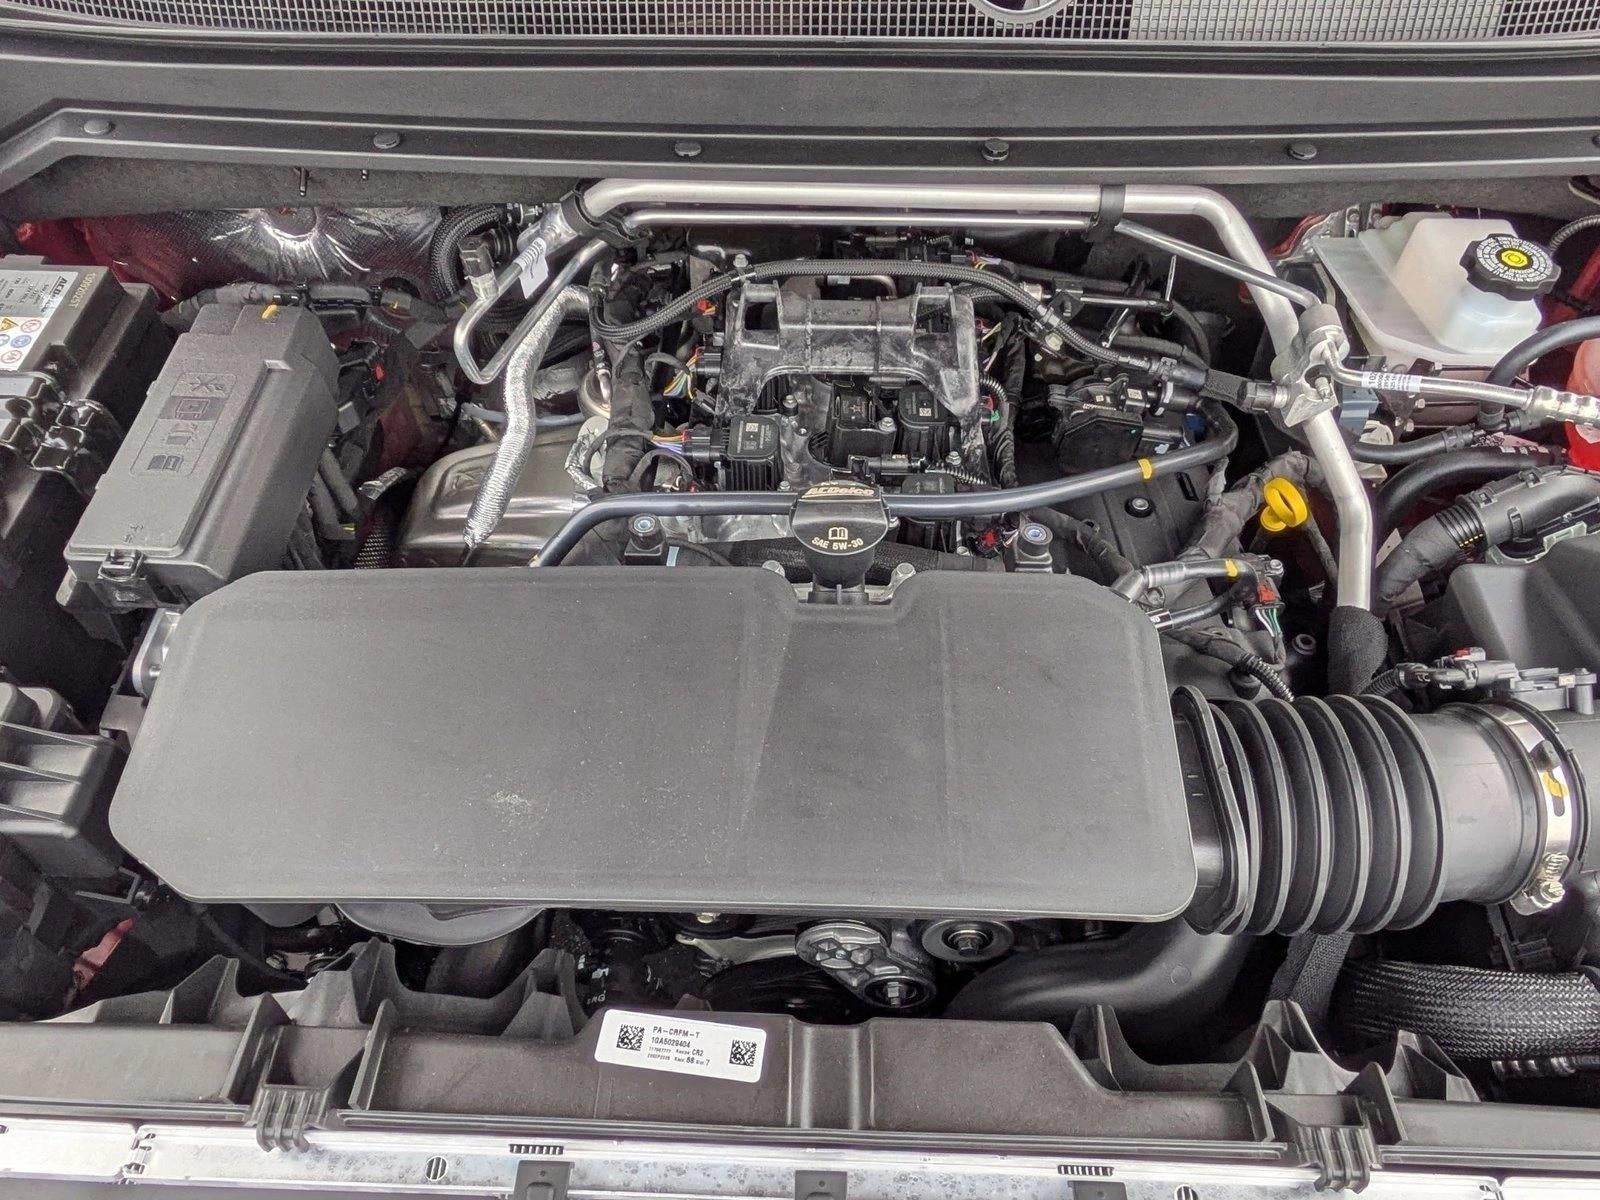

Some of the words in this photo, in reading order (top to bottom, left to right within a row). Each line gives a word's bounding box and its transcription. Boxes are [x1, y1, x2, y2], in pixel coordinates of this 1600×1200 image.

[802, 486, 875, 498] ACDelco
[811, 536, 830, 549] SAE
[832, 537, 864, 550] 5W-30
[652, 1025, 701, 1039] PA-CRFM-T
